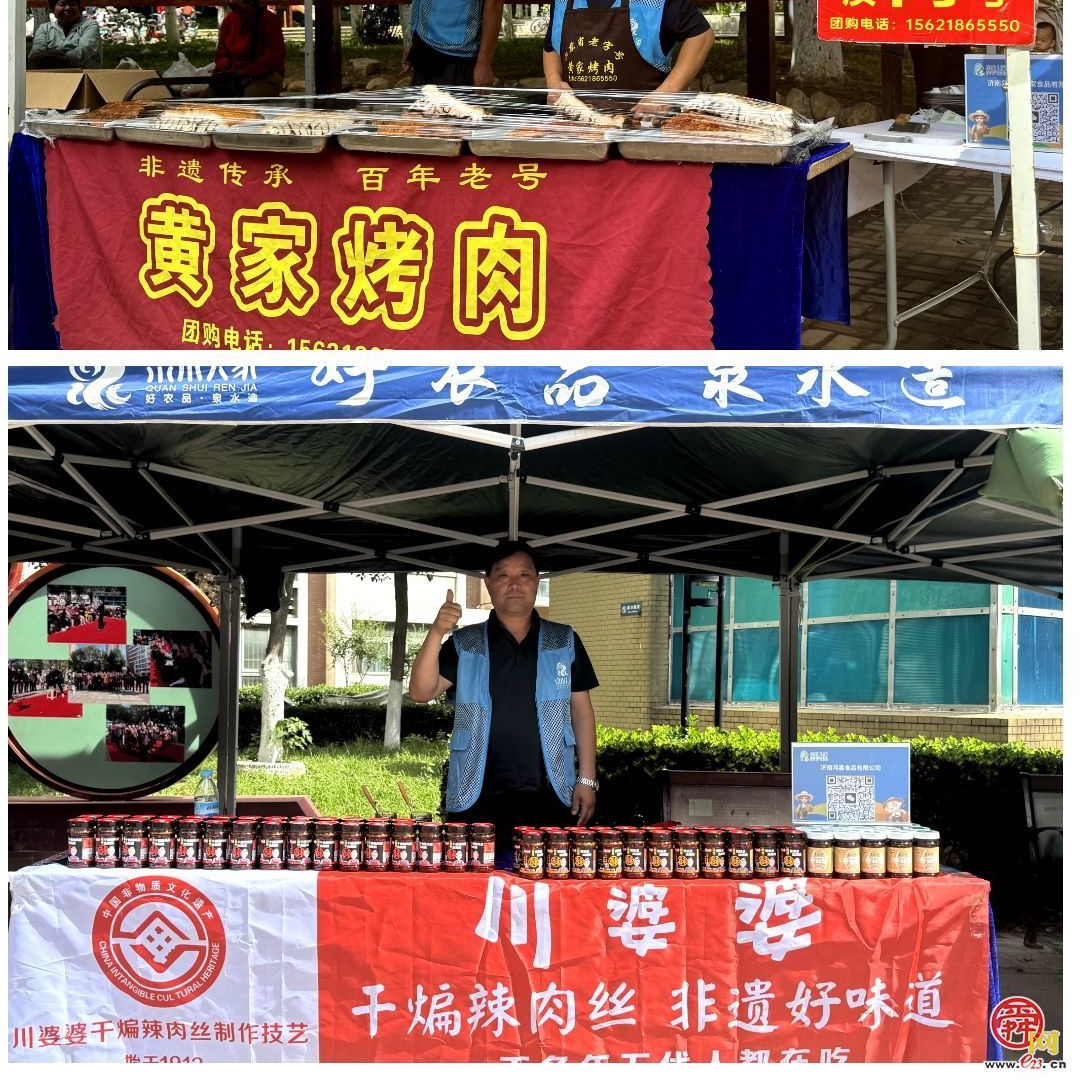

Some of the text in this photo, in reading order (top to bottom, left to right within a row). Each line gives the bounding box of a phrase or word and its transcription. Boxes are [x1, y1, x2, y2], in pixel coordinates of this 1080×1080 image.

[906, 18, 1021, 33] 15621865550
[138, 155, 548, 192] 非遗传承 百年老号
[138, 193, 547, 341] 黄家烤肉
[145, 383, 258, 392] QUAN SHUI REN JIA
[101, 880, 214, 920] 中国非物质文化遗产
[475, 876, 822, 970] 川婆婆
[98, 940, 114, 969] CHINA
[110, 966, 156, 1002] INTANGIBLE
[201, 942, 220, 985] HERITAGE
[352, 972, 954, 1039] 干煸辣肉丝 非遗好味道
[13, 1019, 308, 1049] 川婆婆干煸辣肉丝制作技艺
